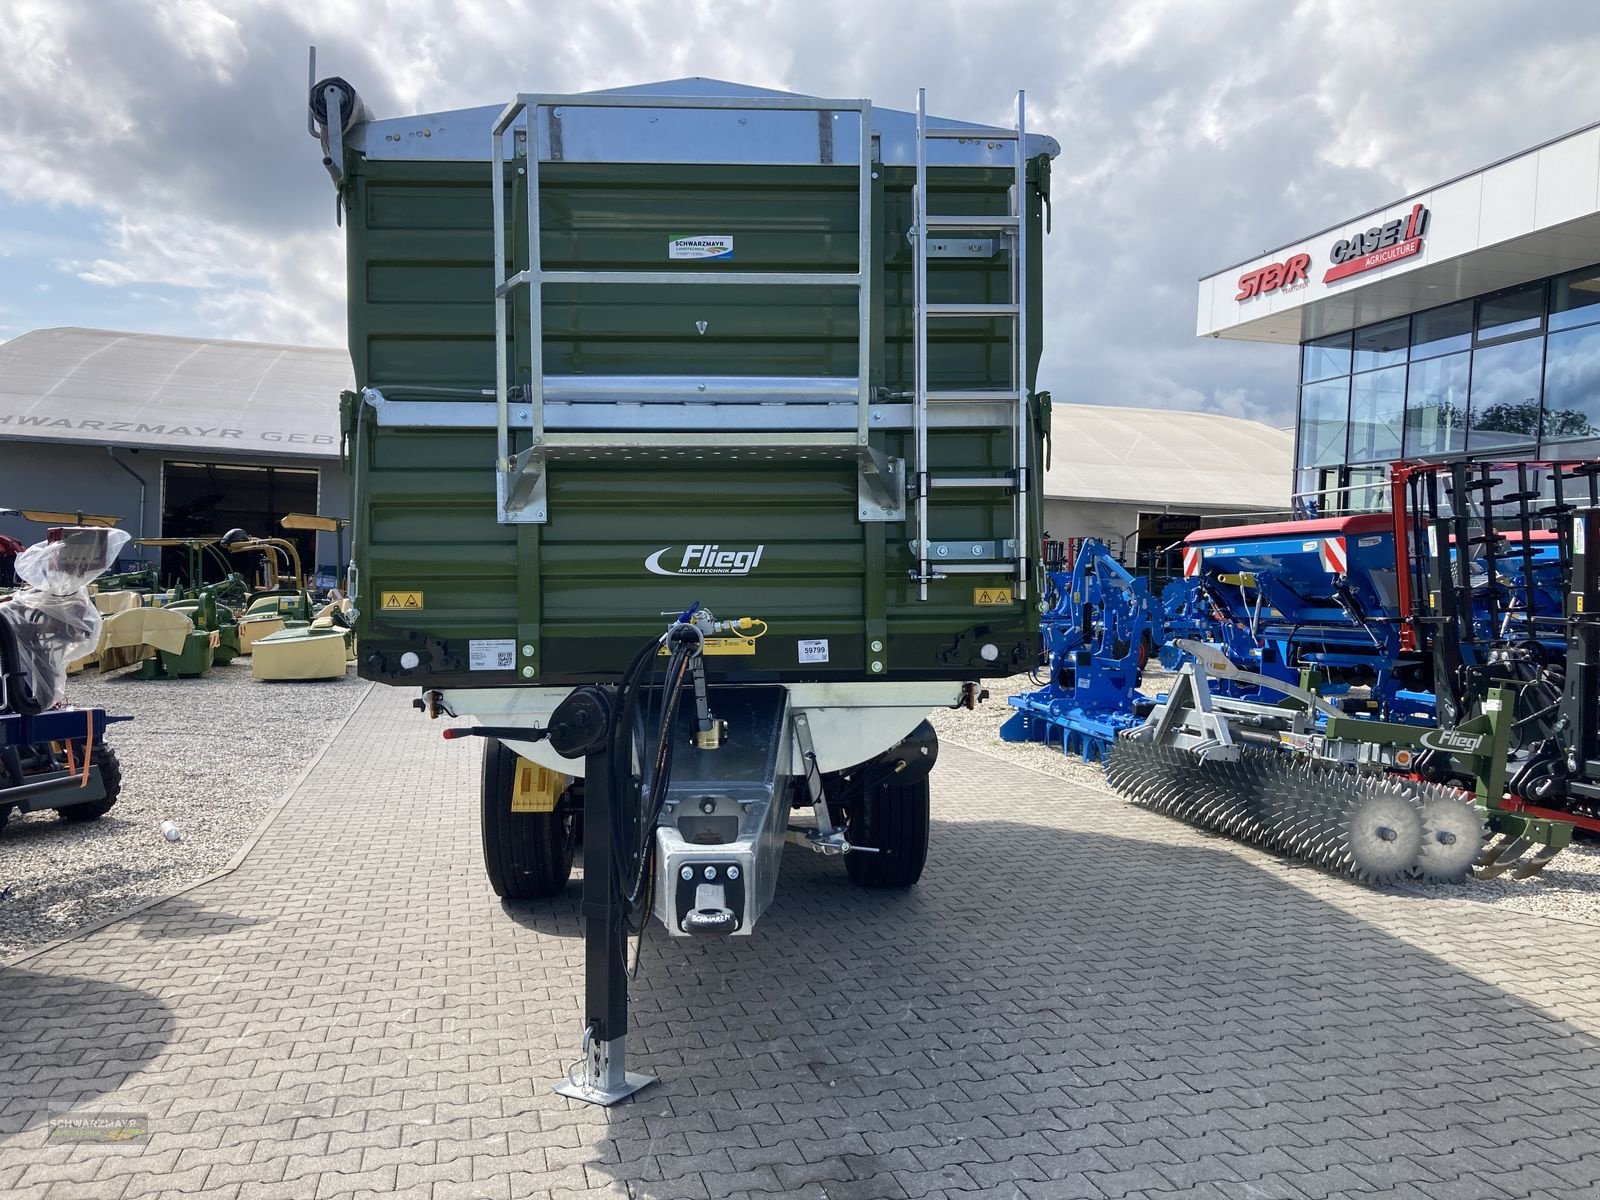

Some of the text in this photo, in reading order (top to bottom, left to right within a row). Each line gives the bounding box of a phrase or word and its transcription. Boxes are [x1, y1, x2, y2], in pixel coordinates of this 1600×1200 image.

[1365, 242, 1416, 267] AGRICULTURE
[1235, 252, 1312, 301] STEYR
[260, 431, 334, 445] GEB
[680, 544, 765, 574] Fliegl
[804, 646, 826, 654] 59799
[1438, 730, 1484, 751] Fliegl
